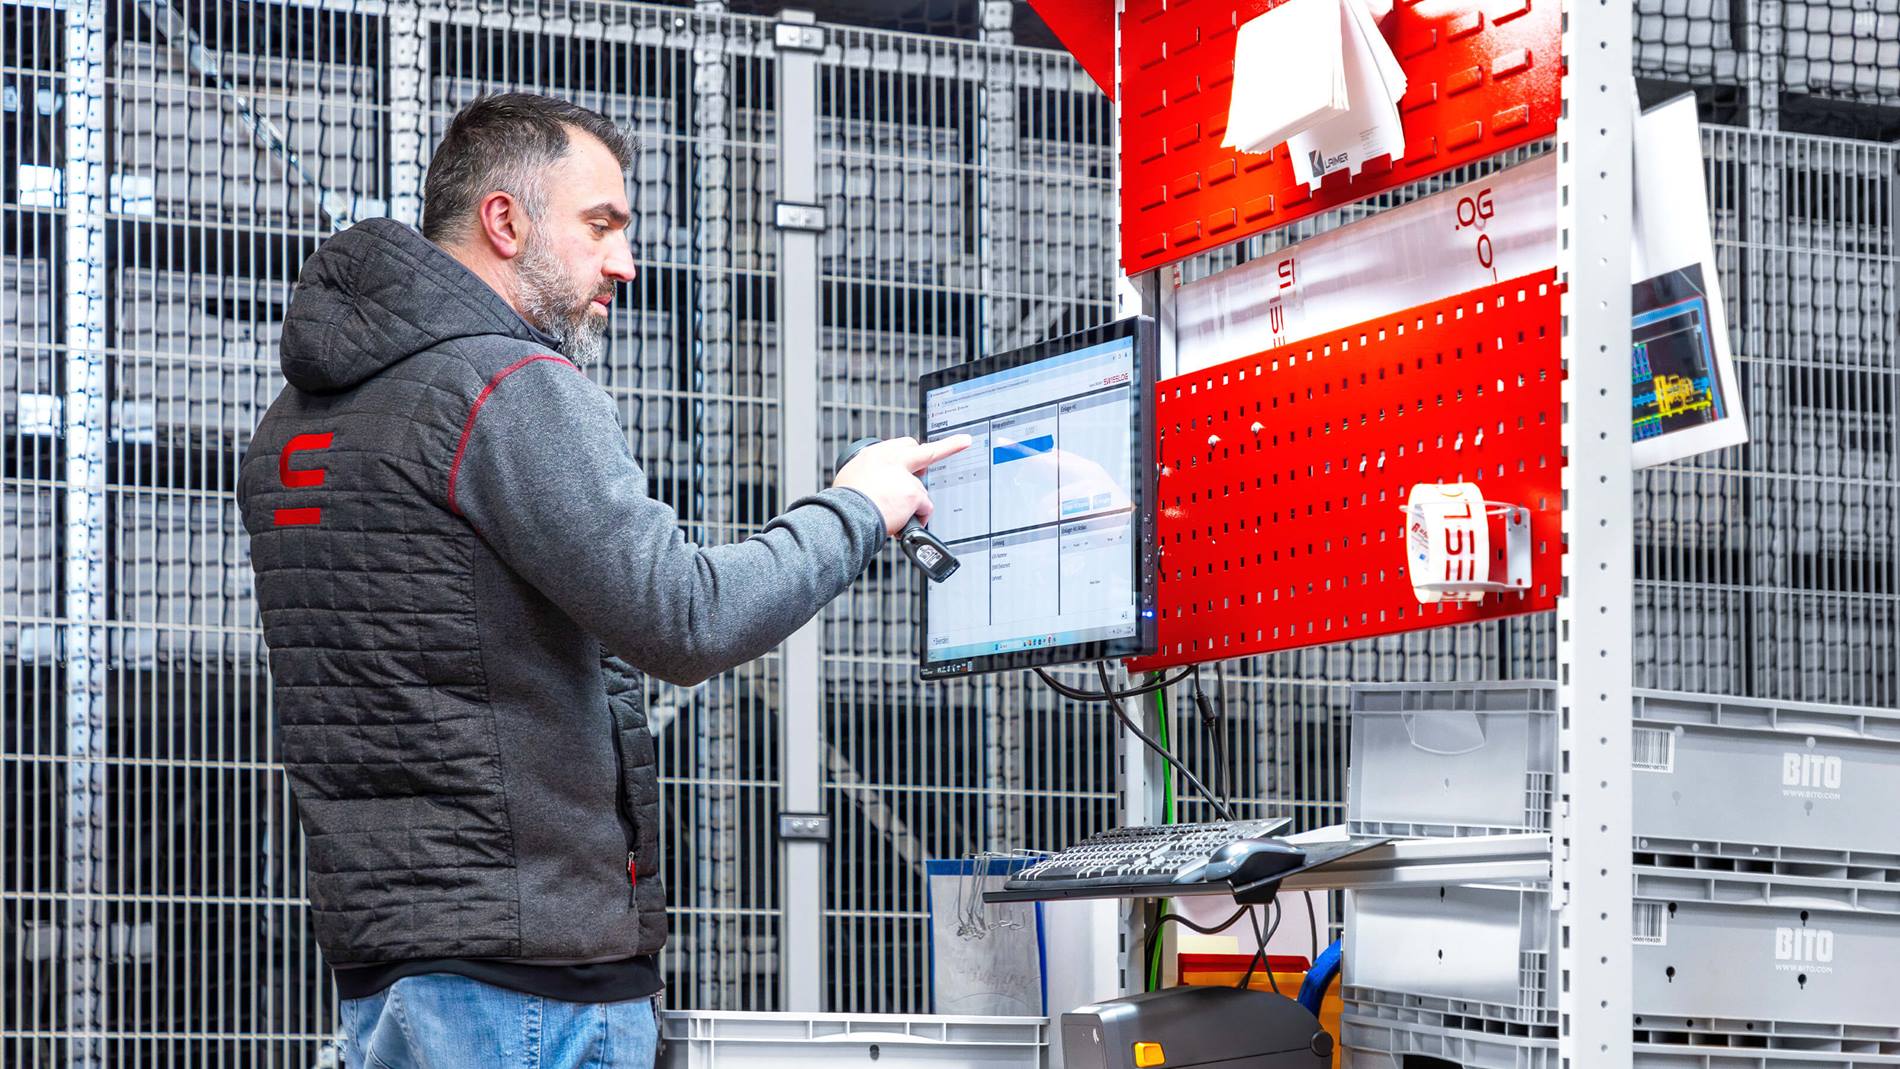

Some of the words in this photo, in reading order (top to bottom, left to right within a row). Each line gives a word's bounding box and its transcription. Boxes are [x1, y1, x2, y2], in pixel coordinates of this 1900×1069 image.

[1325, 152, 1349, 169] LAIMER
[1782, 752, 1842, 788] BITO
[1775, 927, 1833, 962] BITO
